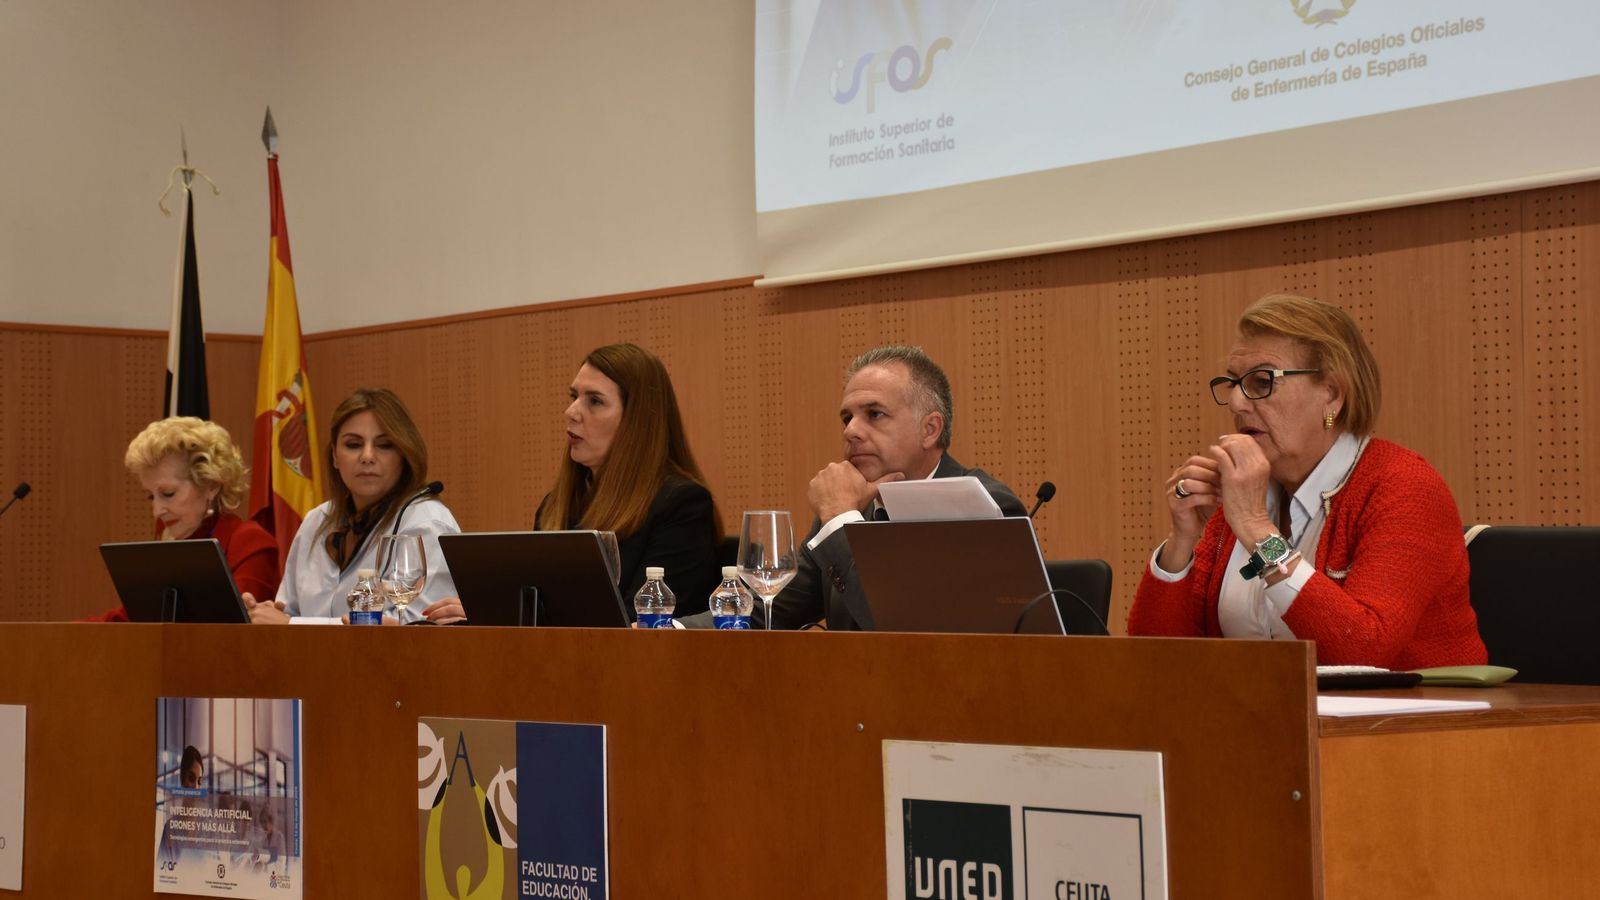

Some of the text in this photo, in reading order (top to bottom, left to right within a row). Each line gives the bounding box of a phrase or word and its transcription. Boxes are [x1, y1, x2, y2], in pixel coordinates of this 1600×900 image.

[1184, 16, 1485, 89] Consejo General de Colegios Oficiales
[1231, 52, 1428, 102] de Enfermería de España
[828, 112, 955, 148] Instituto Superior de
[828, 136, 956, 169] Formación Sanitaria
[169, 806, 213, 818] INTELIGENCIA
[169, 820, 196, 831] DRONES
[196, 822, 201, 831] Y
[201, 820, 217, 832] MÁS
[521, 860, 598, 882] FACULTAD DE
[914, 856, 1003, 900] UNED
